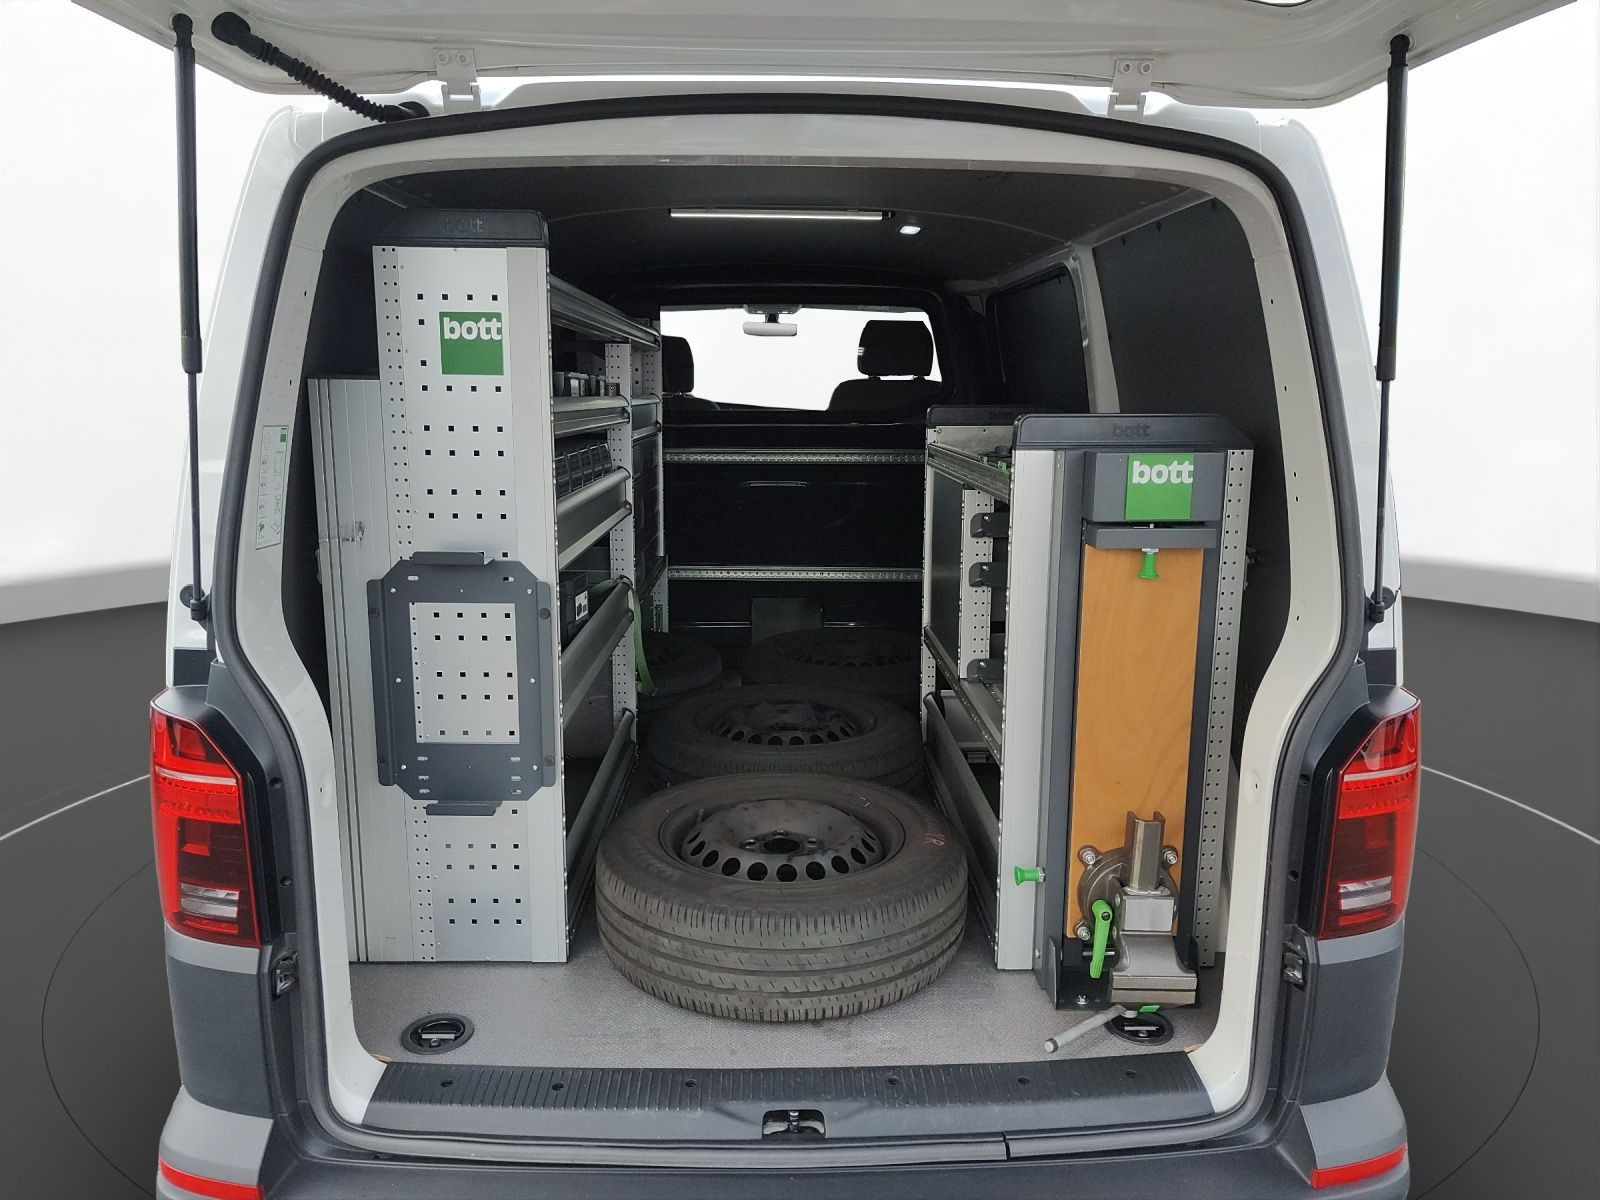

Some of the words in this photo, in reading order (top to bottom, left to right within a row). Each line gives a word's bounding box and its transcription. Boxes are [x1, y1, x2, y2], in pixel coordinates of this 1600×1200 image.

[443, 316, 502, 340] bott
[1112, 422, 1151, 438] bott
[1132, 460, 1194, 484] bott
